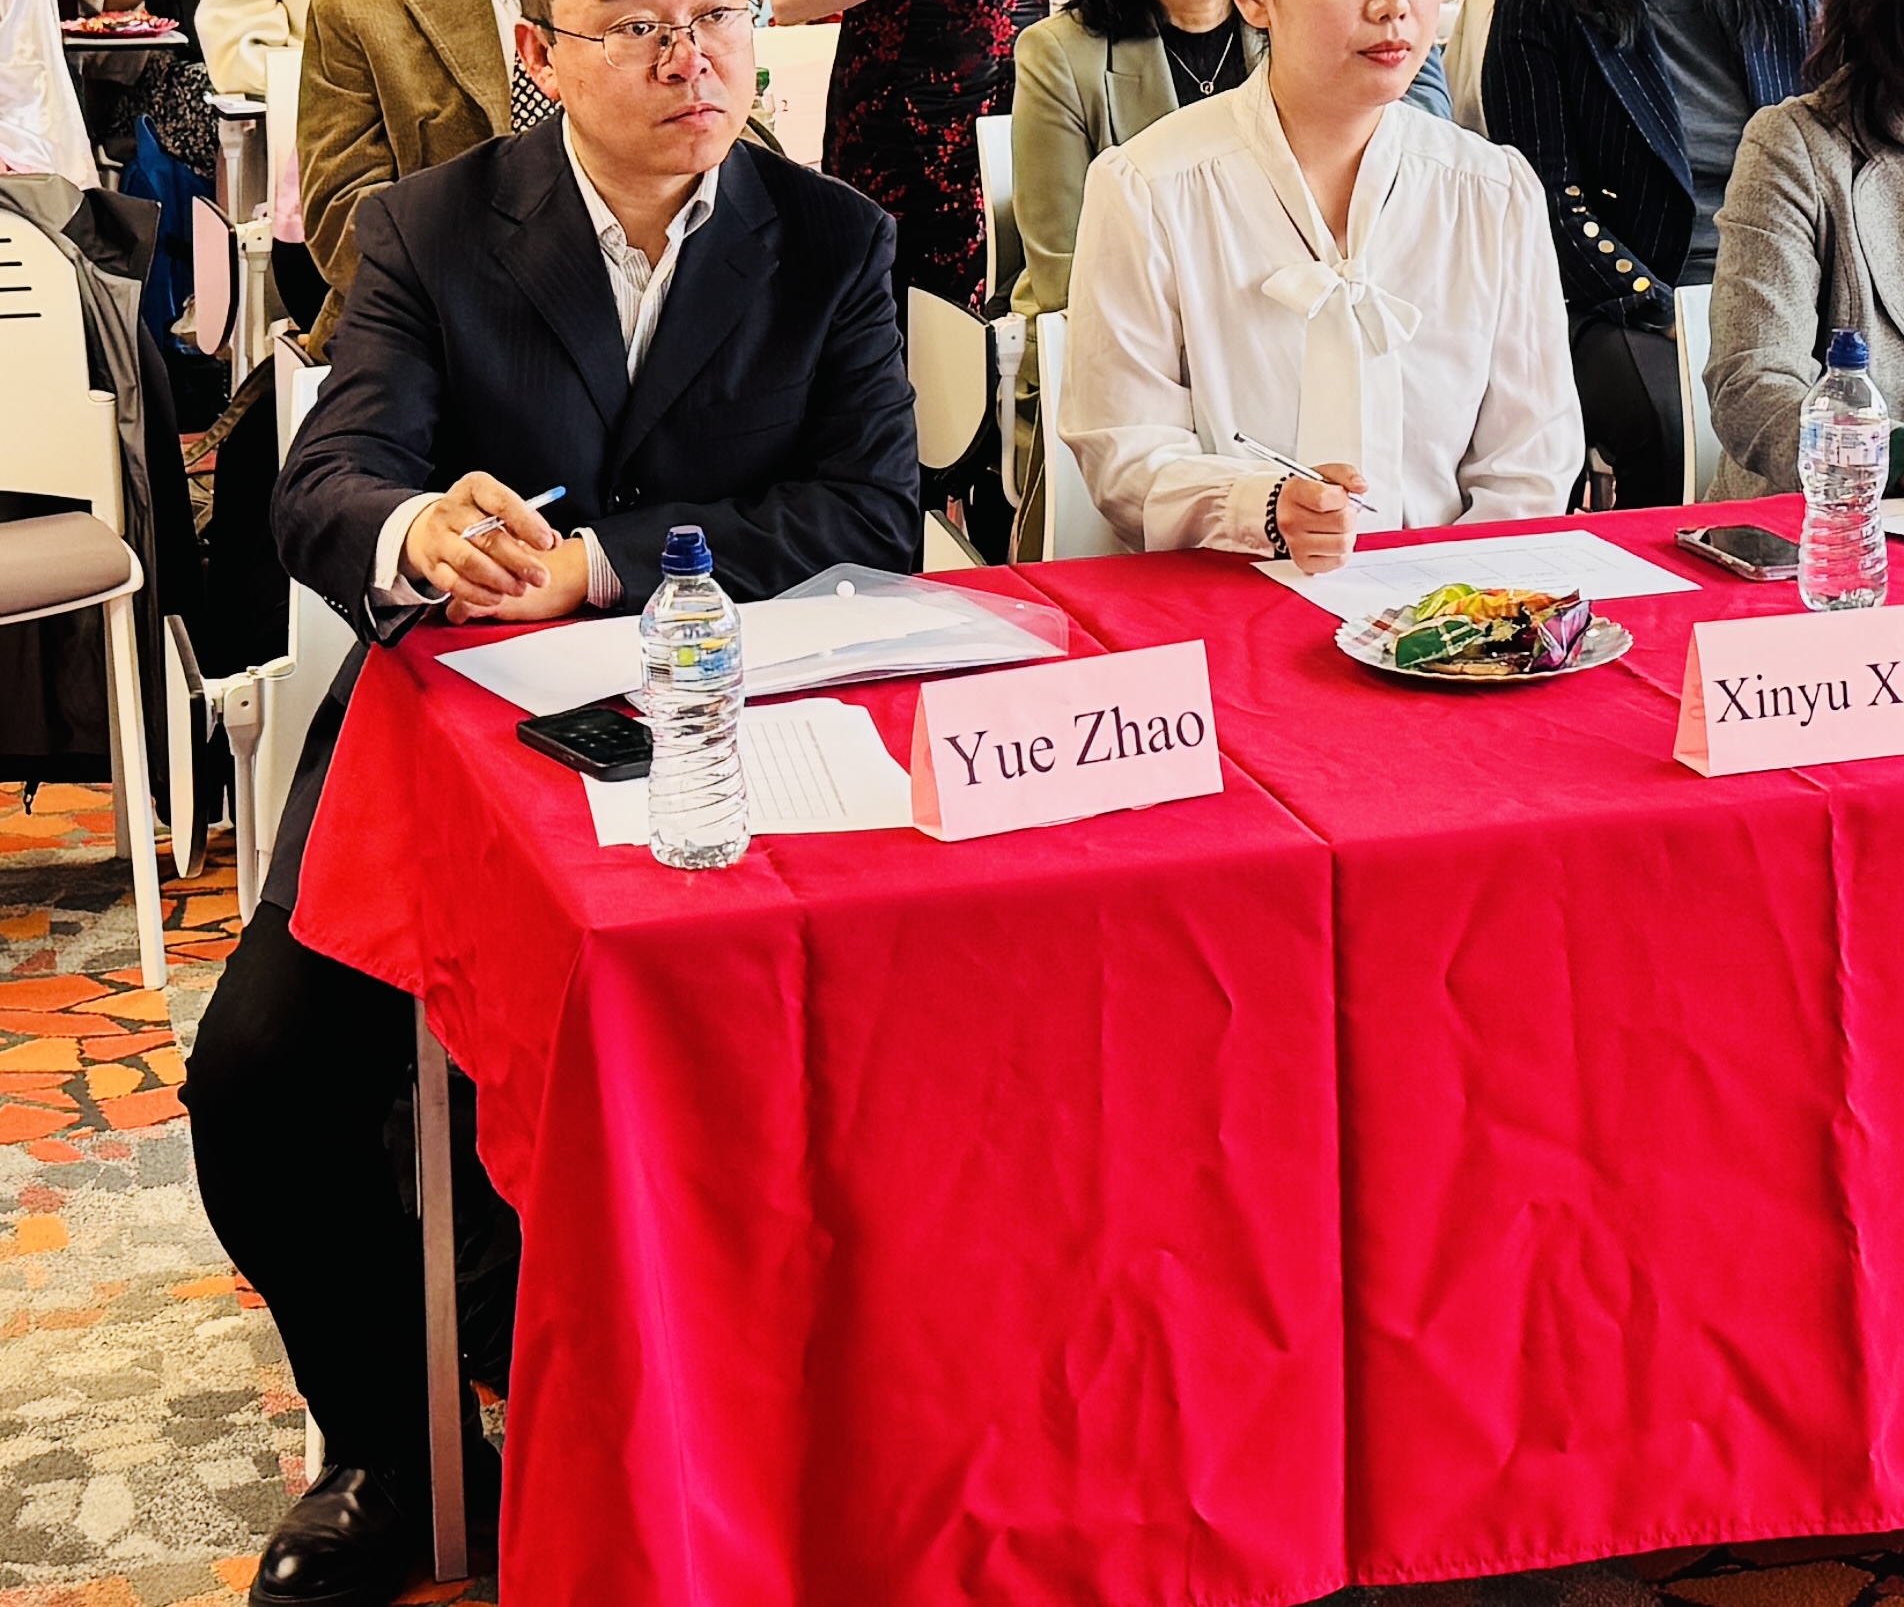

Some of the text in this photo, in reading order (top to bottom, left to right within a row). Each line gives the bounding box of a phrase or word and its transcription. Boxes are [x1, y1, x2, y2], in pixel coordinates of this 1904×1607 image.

[1713, 674, 1852, 727] Xinyu
[943, 706, 1205, 785] Yue Zhao
